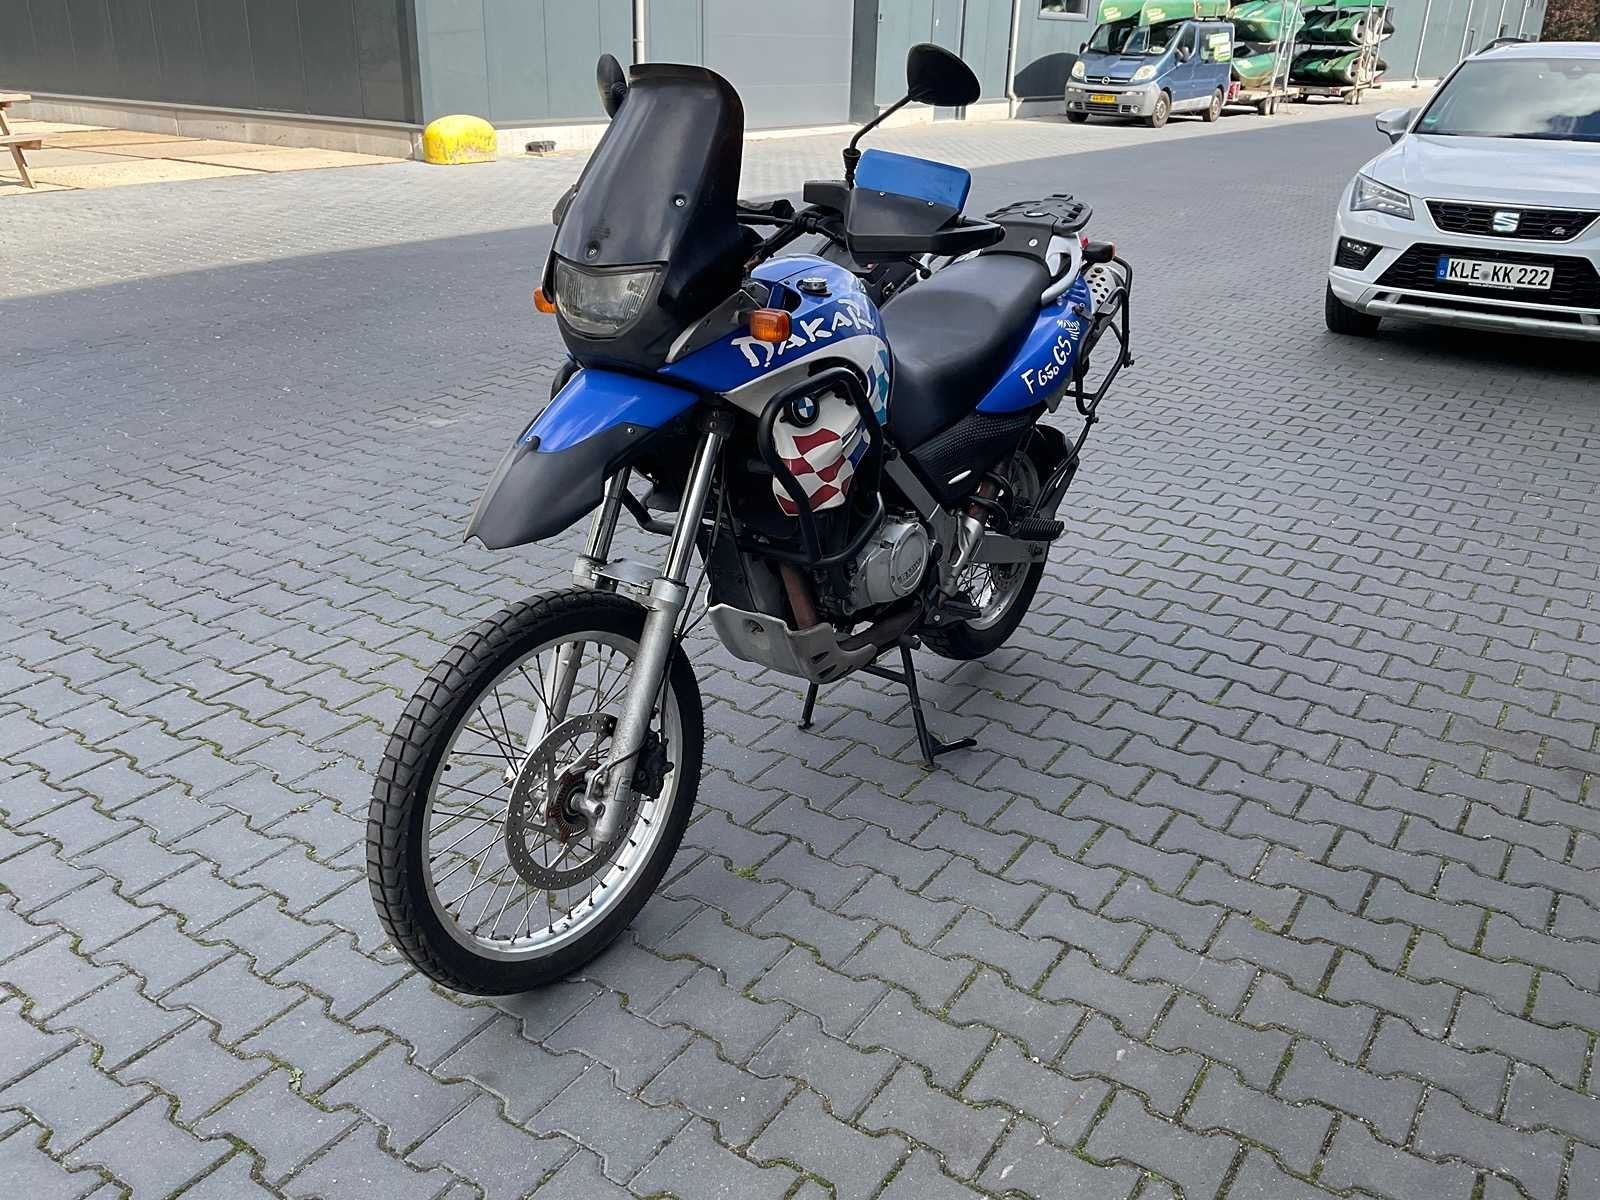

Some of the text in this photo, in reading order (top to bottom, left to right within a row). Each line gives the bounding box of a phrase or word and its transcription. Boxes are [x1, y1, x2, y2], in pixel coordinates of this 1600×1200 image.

[1449, 261, 1482, 280] KLE
[1491, 265, 1514, 283] KK
[1517, 267, 1549, 286] 222
[731, 298, 875, 368] DAKAR
[1020, 335, 1072, 395] F 650 GS
